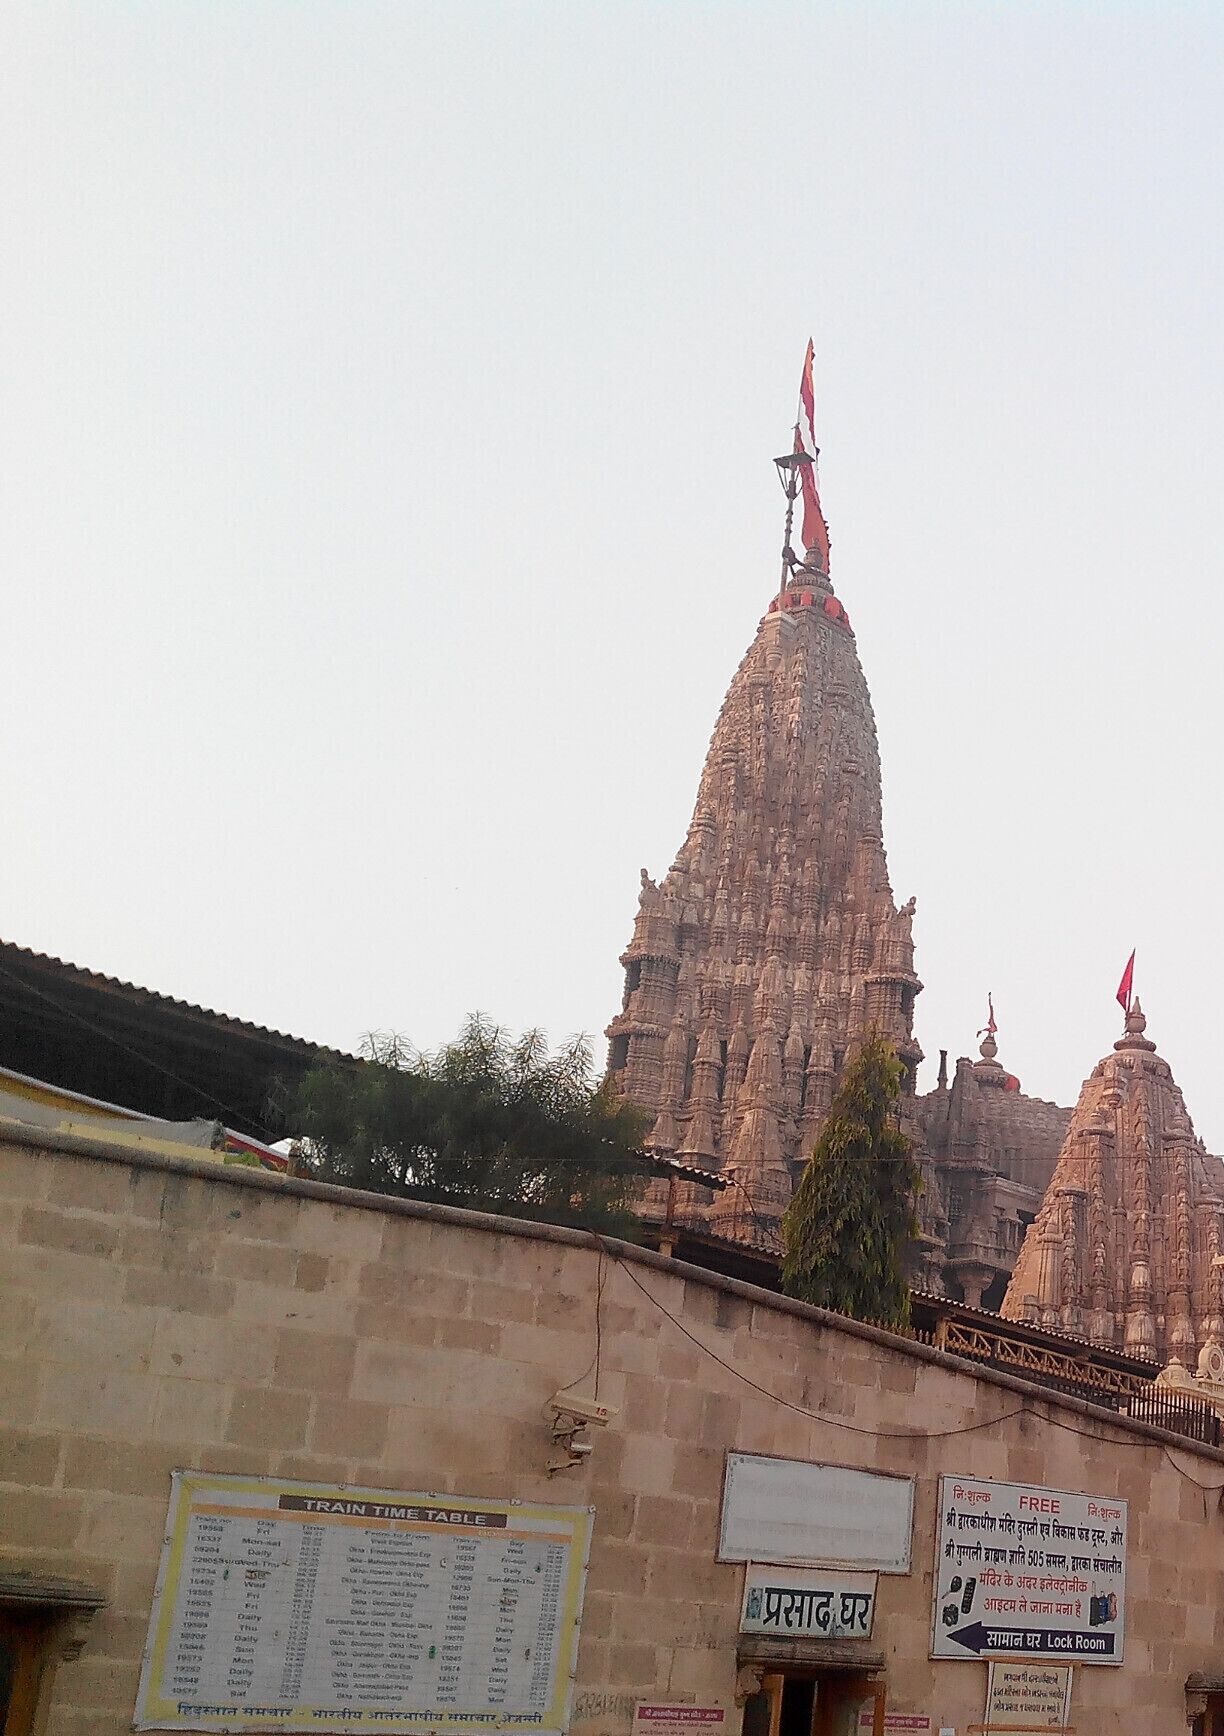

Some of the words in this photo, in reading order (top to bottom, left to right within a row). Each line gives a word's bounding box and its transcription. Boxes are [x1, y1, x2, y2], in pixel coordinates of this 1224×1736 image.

[1019, 1495, 1061, 1514] FREE
[303, 1499, 366, 1516] TRAIN
[372, 1505, 419, 1521] TIME
[425, 1509, 487, 1526] TABLE
[256, 1527, 271, 1536] Fri
[946, 1507, 956, 1527] श्री
[957, 1511, 997, 1533] द्वारकाधीश
[998, 1513, 1016, 1535] मंदिर
[1039, 1517, 1050, 1542] एवं
[1052, 1518, 1076, 1541] विकास
[1077, 1522, 1090, 1542] फंड
[1110, 1525, 1124, 1546] और
[247, 1548, 273, 1558] Daily
[945, 1539, 955, 1560] श्री
[1028, 1550, 1044, 1568] 505
[1071, 1555, 1092, 1572] द्वारका
[979, 1567, 1001, 1587] मंदिर
[1003, 1570, 1014, 1588] के
[1016, 1571, 1038, 1590] अंदर
[246, 1591, 260, 1600] Fri
[244, 1601, 259, 1610] Fri
[762, 1587, 835, 1632] प्रसाद
[839, 1592, 873, 1631] घर
[983, 1598, 1016, 1614] आइटम
[1018, 1595, 1028, 1613] ले
[1030, 1601, 1053, 1615] जाना
[1055, 1602, 1073, 1616] मना
[1075, 1600, 1082, 1618] है
[237, 1613, 263, 1622] Daily
[239, 1623, 258, 1632] Thu
[233, 1634, 259, 1644] Daily
[986, 1630, 1025, 1648] सामान
[1026, 1632, 1041, 1648] घर
[1047, 1634, 1073, 1650] Lock
[1075, 1635, 1106, 1650] Room
[232, 1656, 255, 1665] Mon
[229, 1668, 254, 1677] Daily
[226, 1679, 252, 1689] Daily
